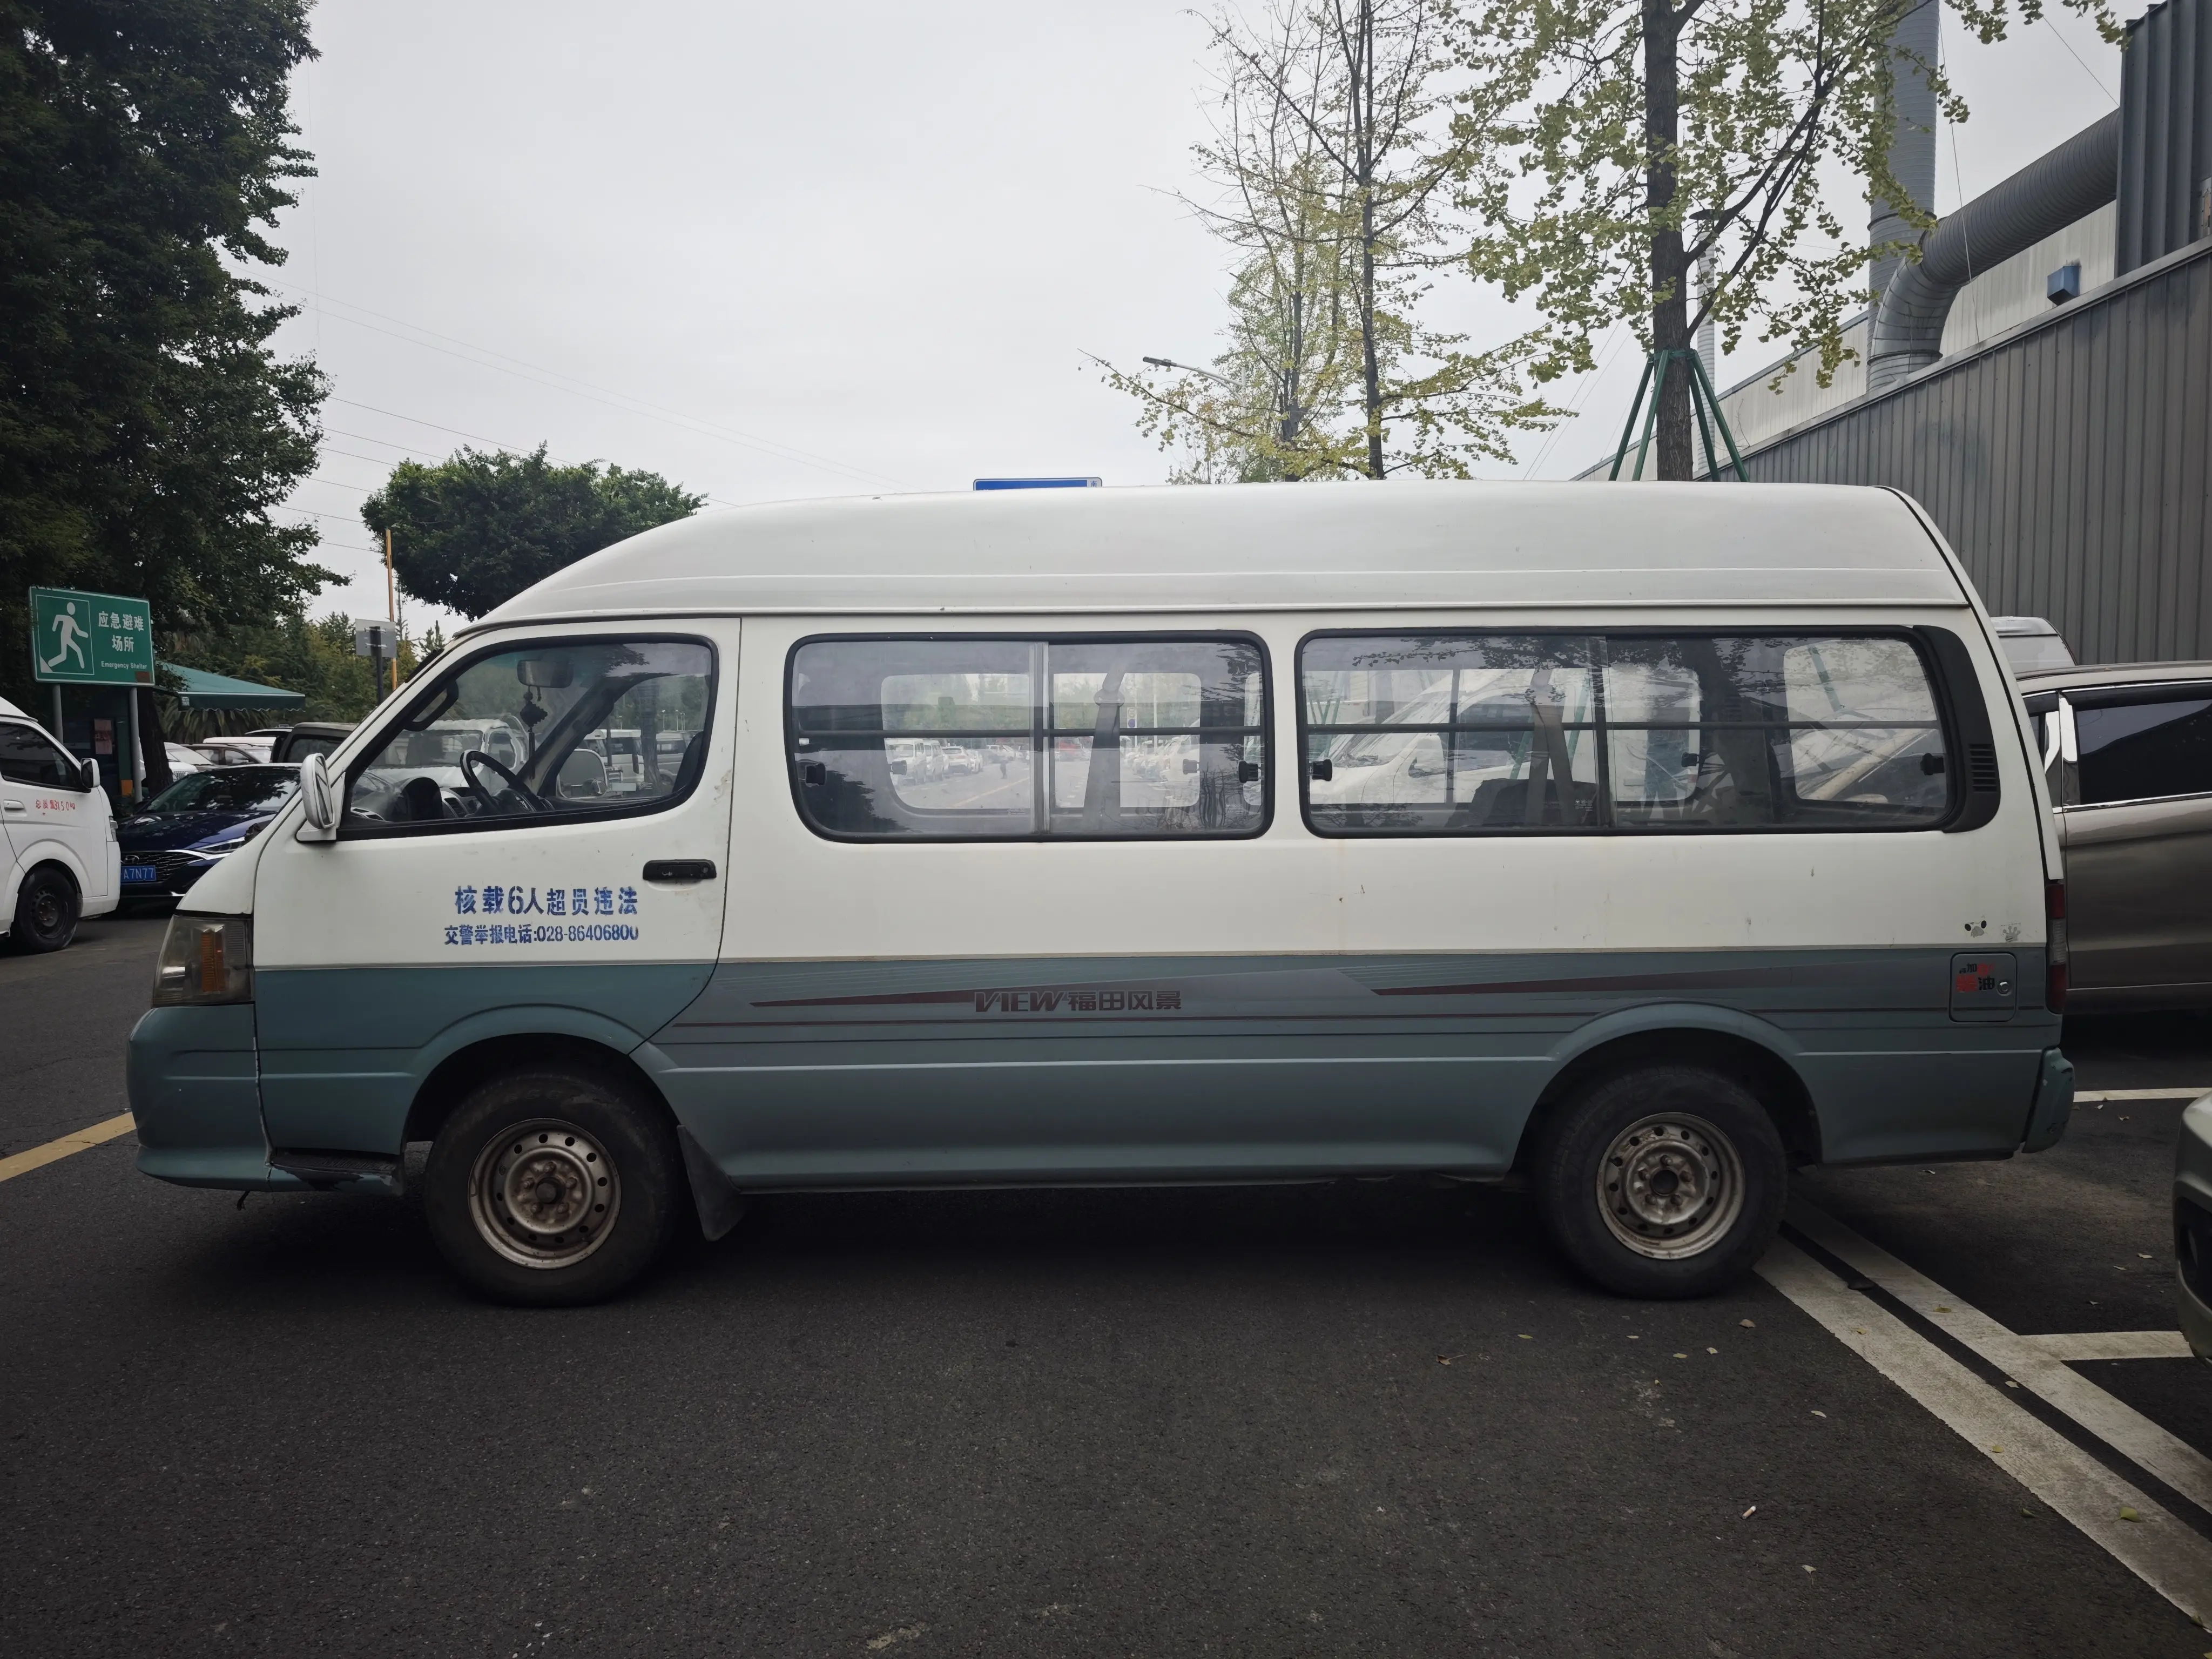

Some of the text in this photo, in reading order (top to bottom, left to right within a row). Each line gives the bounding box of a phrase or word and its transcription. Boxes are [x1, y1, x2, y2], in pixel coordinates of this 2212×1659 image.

[98, 611, 144, 631] 应急避难
[112, 635, 134, 652] 场所
[101, 661, 129, 670] Emergency
[455, 885, 638, 916] 核载6人超员违法
[444, 924, 639, 946] 交警举报电话:028-86406800
